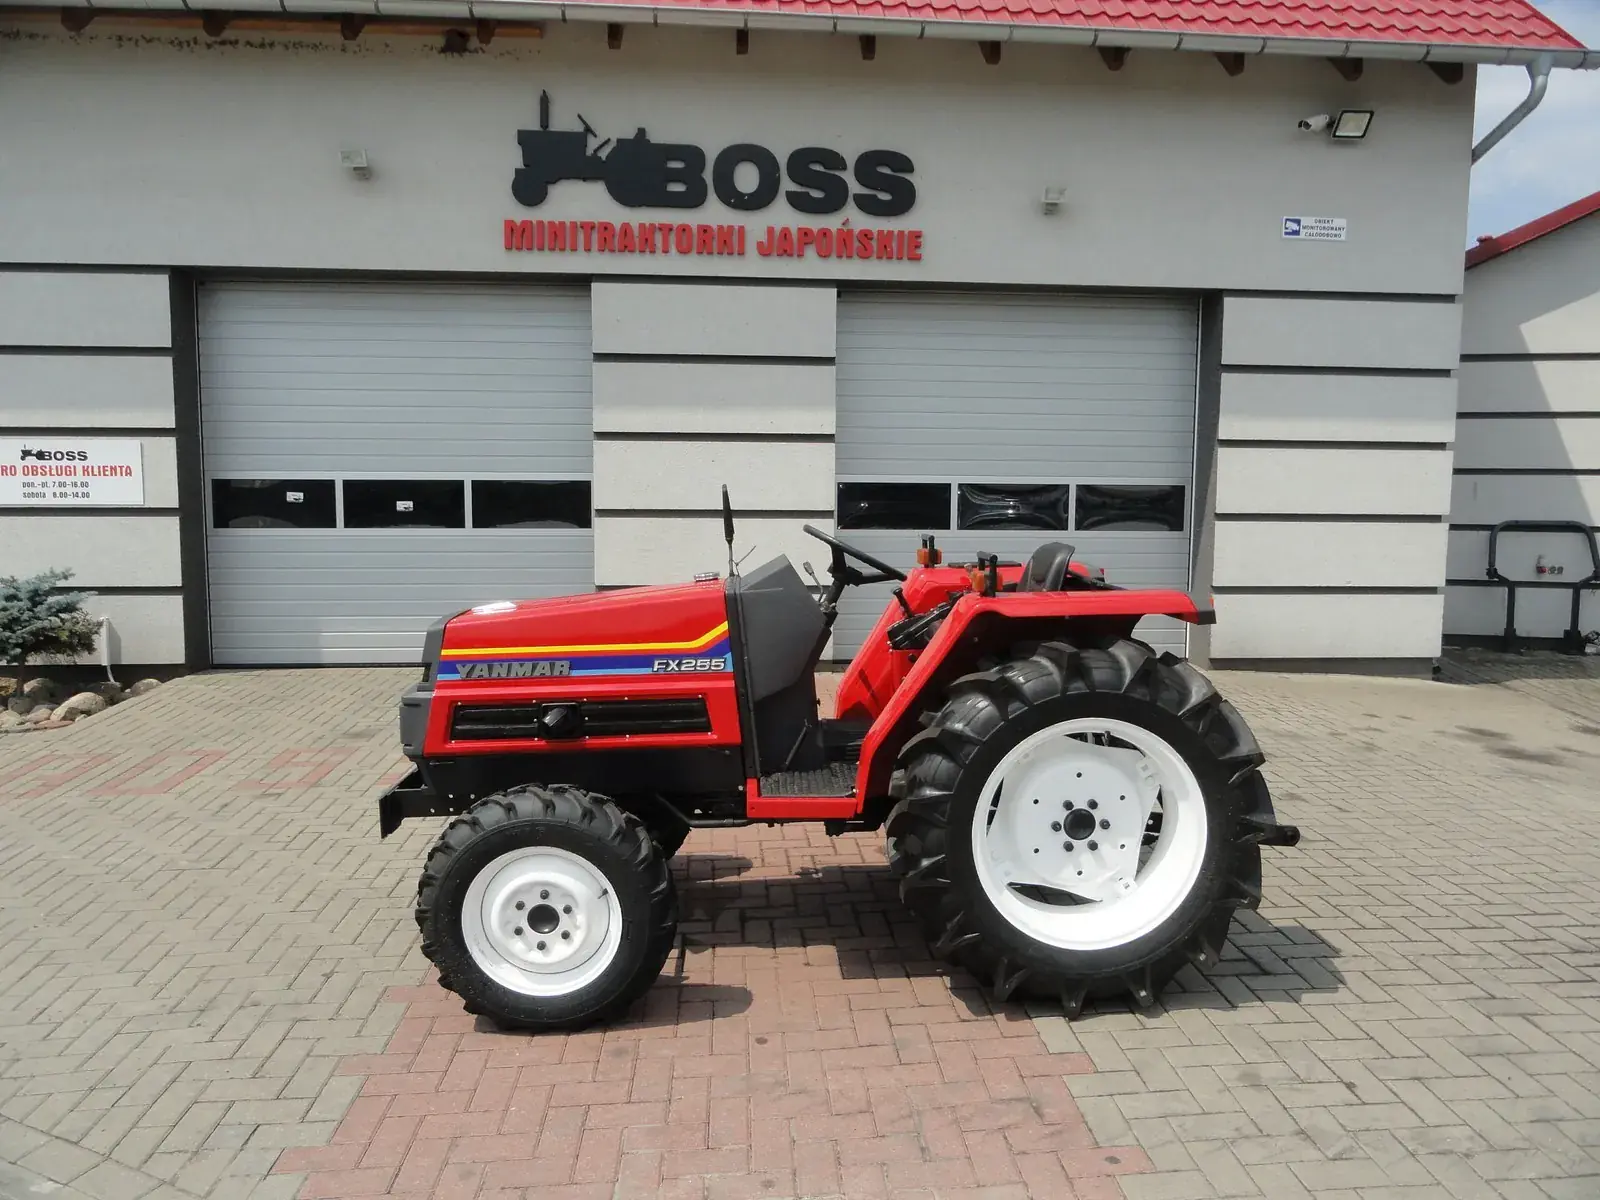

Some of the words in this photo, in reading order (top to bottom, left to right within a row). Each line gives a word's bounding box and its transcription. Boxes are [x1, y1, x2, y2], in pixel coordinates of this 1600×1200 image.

[648, 142, 918, 217] BOSS
[504, 218, 745, 256] MINITRAKTORKI
[756, 217, 923, 261] JAPOŃSKIE
[43, 450, 88, 461] BOSS
[22, 465, 78, 477] OBSŁUGI
[82, 465, 133, 477] KLIENTA
[22, 491, 47, 499] sobota
[455, 659, 572, 680] YANMAR
[652, 658, 727, 674] FX255
